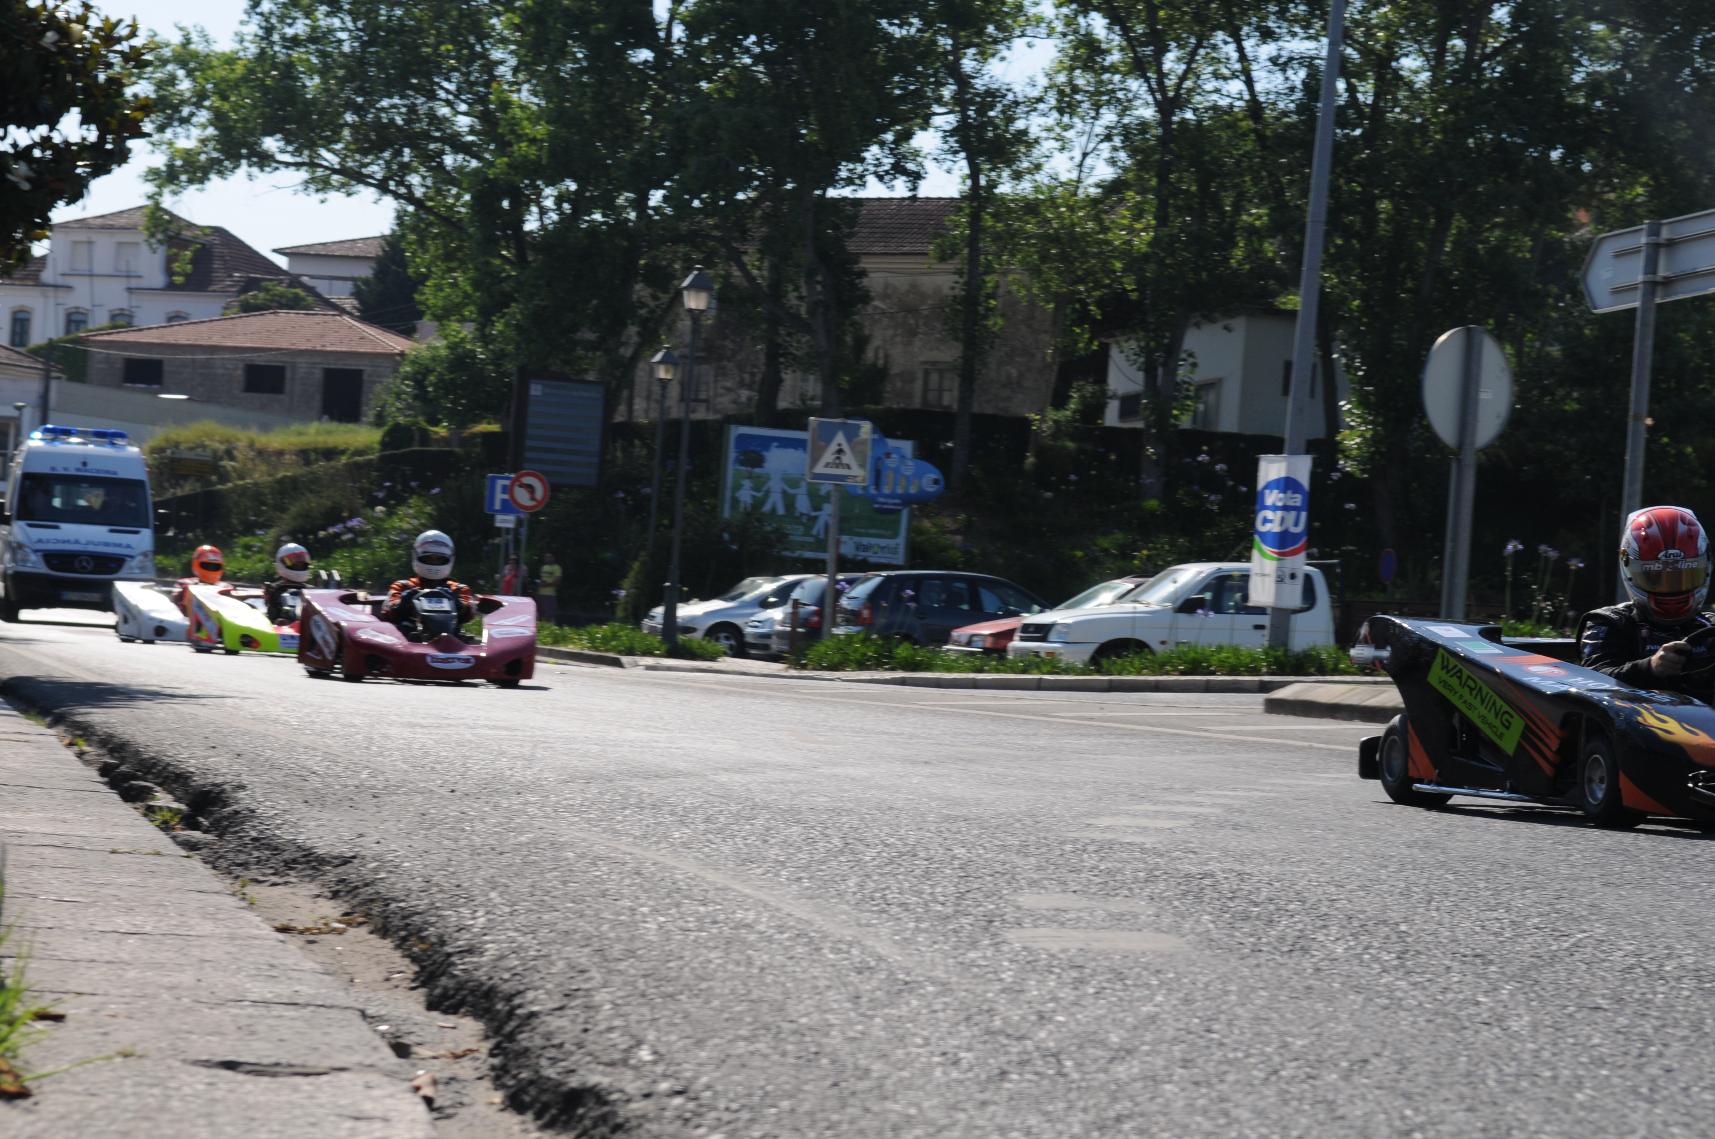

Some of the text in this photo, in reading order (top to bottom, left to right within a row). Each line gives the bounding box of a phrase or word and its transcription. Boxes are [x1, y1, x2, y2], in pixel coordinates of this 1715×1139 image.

[1263, 488, 1303, 507] Vota
[1256, 510, 1307, 533] CDU
[1440, 652, 1515, 731] WARNING
